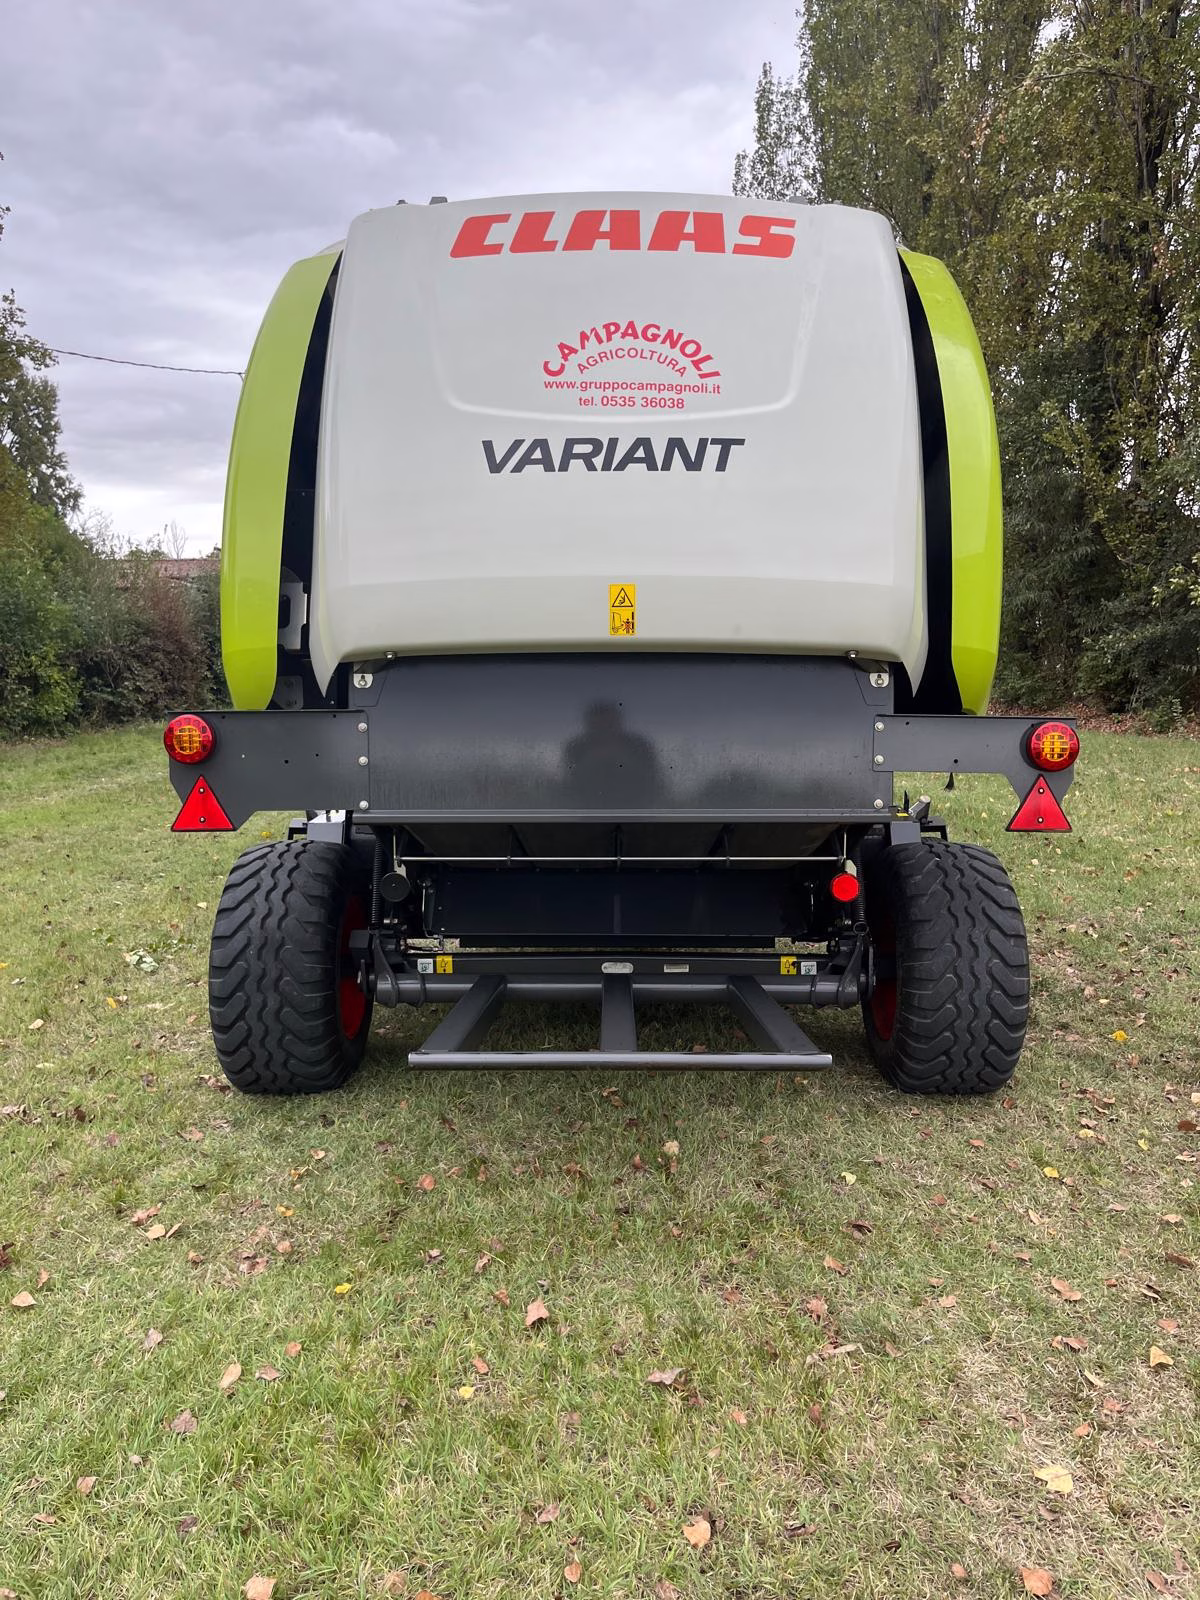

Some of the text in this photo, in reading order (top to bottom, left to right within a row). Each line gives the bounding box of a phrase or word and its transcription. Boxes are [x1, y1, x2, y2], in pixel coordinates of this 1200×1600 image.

[450, 209, 796, 259] CLAAS
[543, 320, 721, 379] CAMPAGNOLI
[577, 347, 687, 377] AGRICOLTURA
[544, 380, 720, 395] www.gruppocampagnoli.it
[579, 395, 685, 409] tel. 0535 36038
[482, 438, 745, 473] VARIANT
